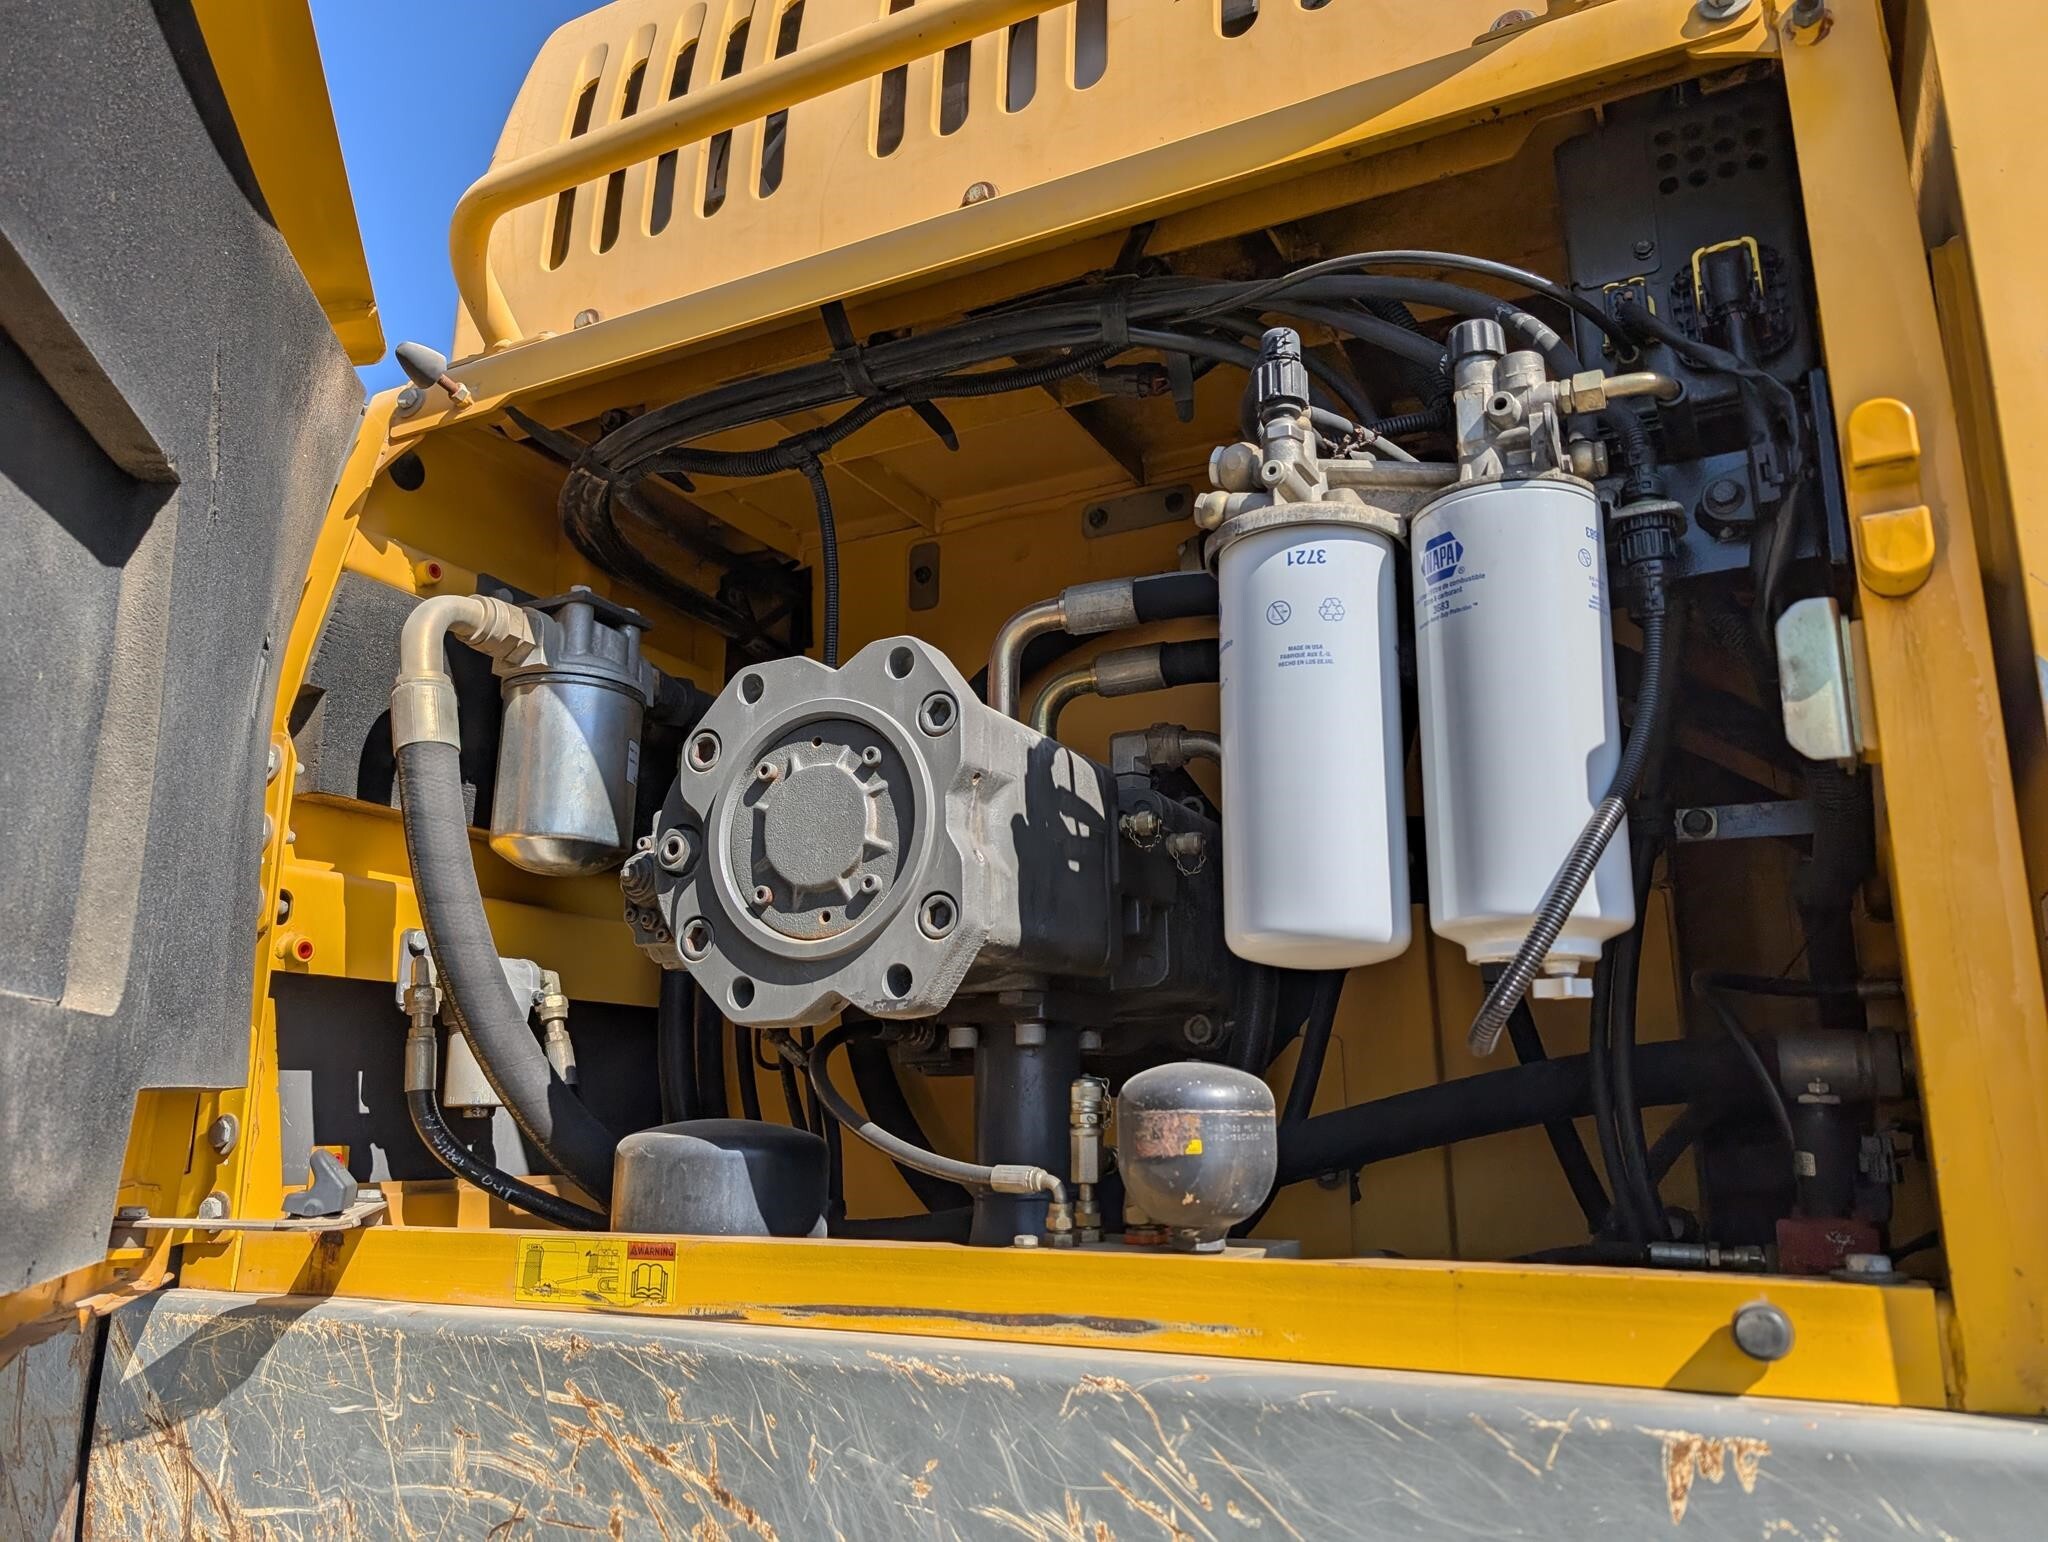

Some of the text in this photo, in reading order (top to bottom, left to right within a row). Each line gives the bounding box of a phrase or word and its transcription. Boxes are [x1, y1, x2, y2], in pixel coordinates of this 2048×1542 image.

[1287, 549, 1327, 566] 3721
[1425, 543, 1455, 575] NAPA
[1278, 659, 1296, 667] HECHO
[637, 1246, 674, 1257] WARNING
